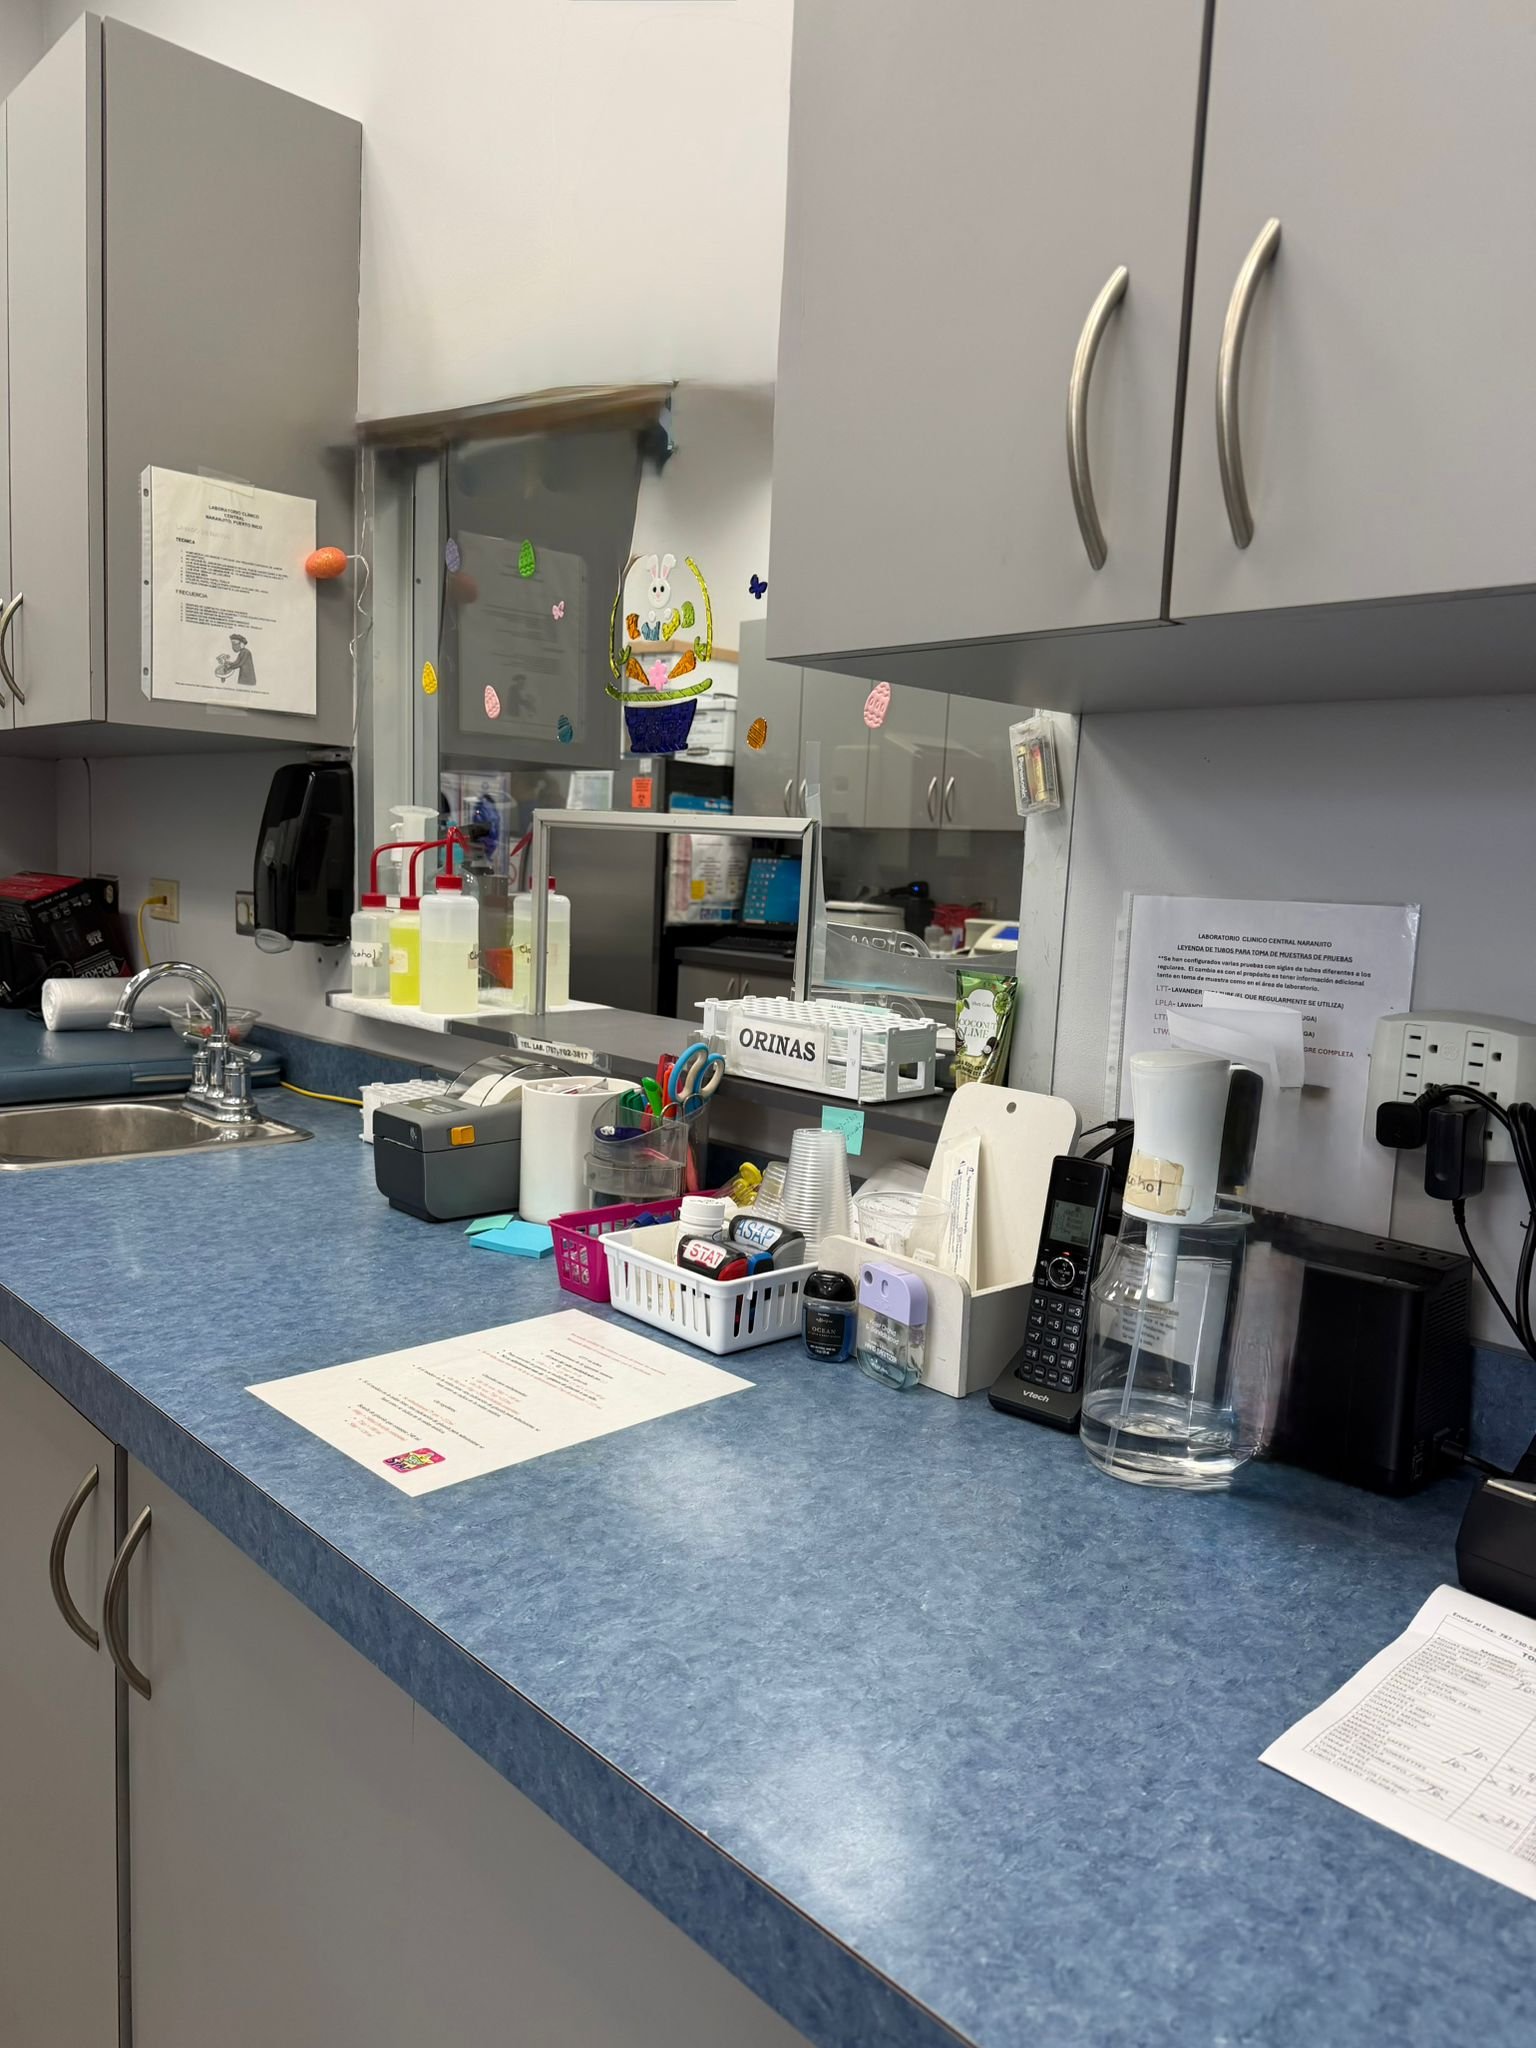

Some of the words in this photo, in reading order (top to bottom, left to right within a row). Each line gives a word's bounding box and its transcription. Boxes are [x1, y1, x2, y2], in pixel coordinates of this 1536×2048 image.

[1198, 933, 1240, 942] LABORATORIO
[1268, 938, 1296, 946] CENTRAL
[1297, 940, 1333, 948] NARANJITO
[1177, 944, 1205, 952] LEYENDA
[1234, 948, 1251, 956] PARA
[1270, 950, 1278, 958] DE
[1279, 952, 1312, 960] MUESTRAS
[1323, 954, 1353, 963] PRUEBAS
[1184, 957, 1221, 965] configurados
[1240, 961, 1264, 969] pruebas
[1322, 968, 1354, 977] diferentes
[1258, 995, 1307, 1006] REGULARMENTE
[739, 1028, 816, 1062] ORINAS
[1318, 1048, 1354, 1058] COMPLETA
[736, 1219, 776, 1247] ASAP
[690, 1244, 724, 1266] STAT
[1056, 1304, 1062, 1312] 2
[1075, 1308, 1081, 1317] 3
[1054, 1321, 1060, 1329] 5
[1072, 1326, 1078, 1334] 6
[812, 1326, 836, 1335] OCEAN
[1051, 1338, 1056, 1346] 8
[1070, 1342, 1075, 1352] 9
[1022, 1390, 1050, 1403] vtech
